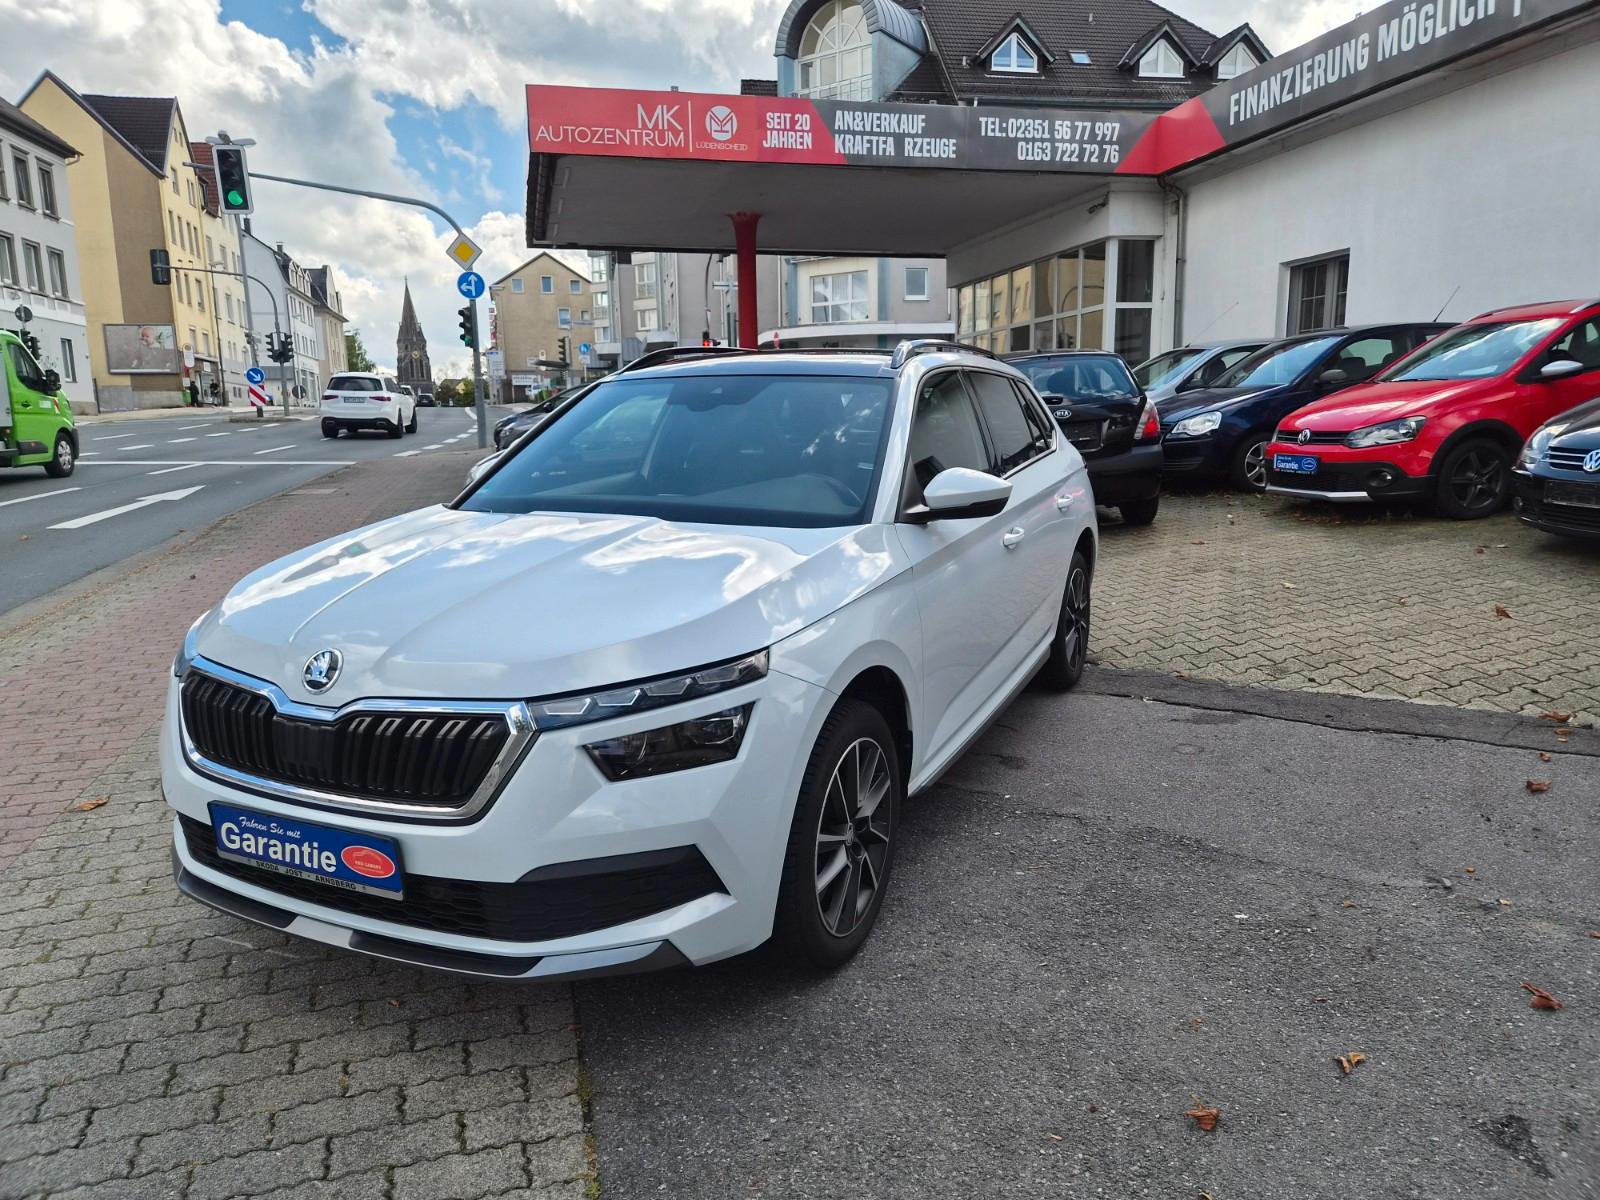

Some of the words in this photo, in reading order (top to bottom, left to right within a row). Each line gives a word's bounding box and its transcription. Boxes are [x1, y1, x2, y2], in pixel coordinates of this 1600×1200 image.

[1229, 33, 1370, 126] FINANZIERUNG
[637, 103, 682, 130] MK
[766, 112, 792, 130] SEIT
[794, 113, 811, 131] 20
[834, 110, 926, 134] AN&VERKAUF
[535, 124, 685, 147] AUTOZENTRUM
[762, 131, 813, 150] JAHREN
[1054, 121, 1071, 139] 56
[1074, 121, 1092, 140] 77
[1094, 122, 1121, 142] 997
[834, 134, 895, 156] KRAFTFA
[904, 138, 957, 159] RZEUGE
[1017, 141, 1051, 161] 0163
[1055, 142, 1079, 162] 722
[1082, 143, 1100, 163] 72
[1102, 144, 1119, 164] 76
[239, 816, 268, 832] Fahren
[270, 823, 285, 835] Sie
[286, 830, 301, 839] mit
[221, 822, 337, 872] Garantie
[285, 868, 304, 878] JOST
